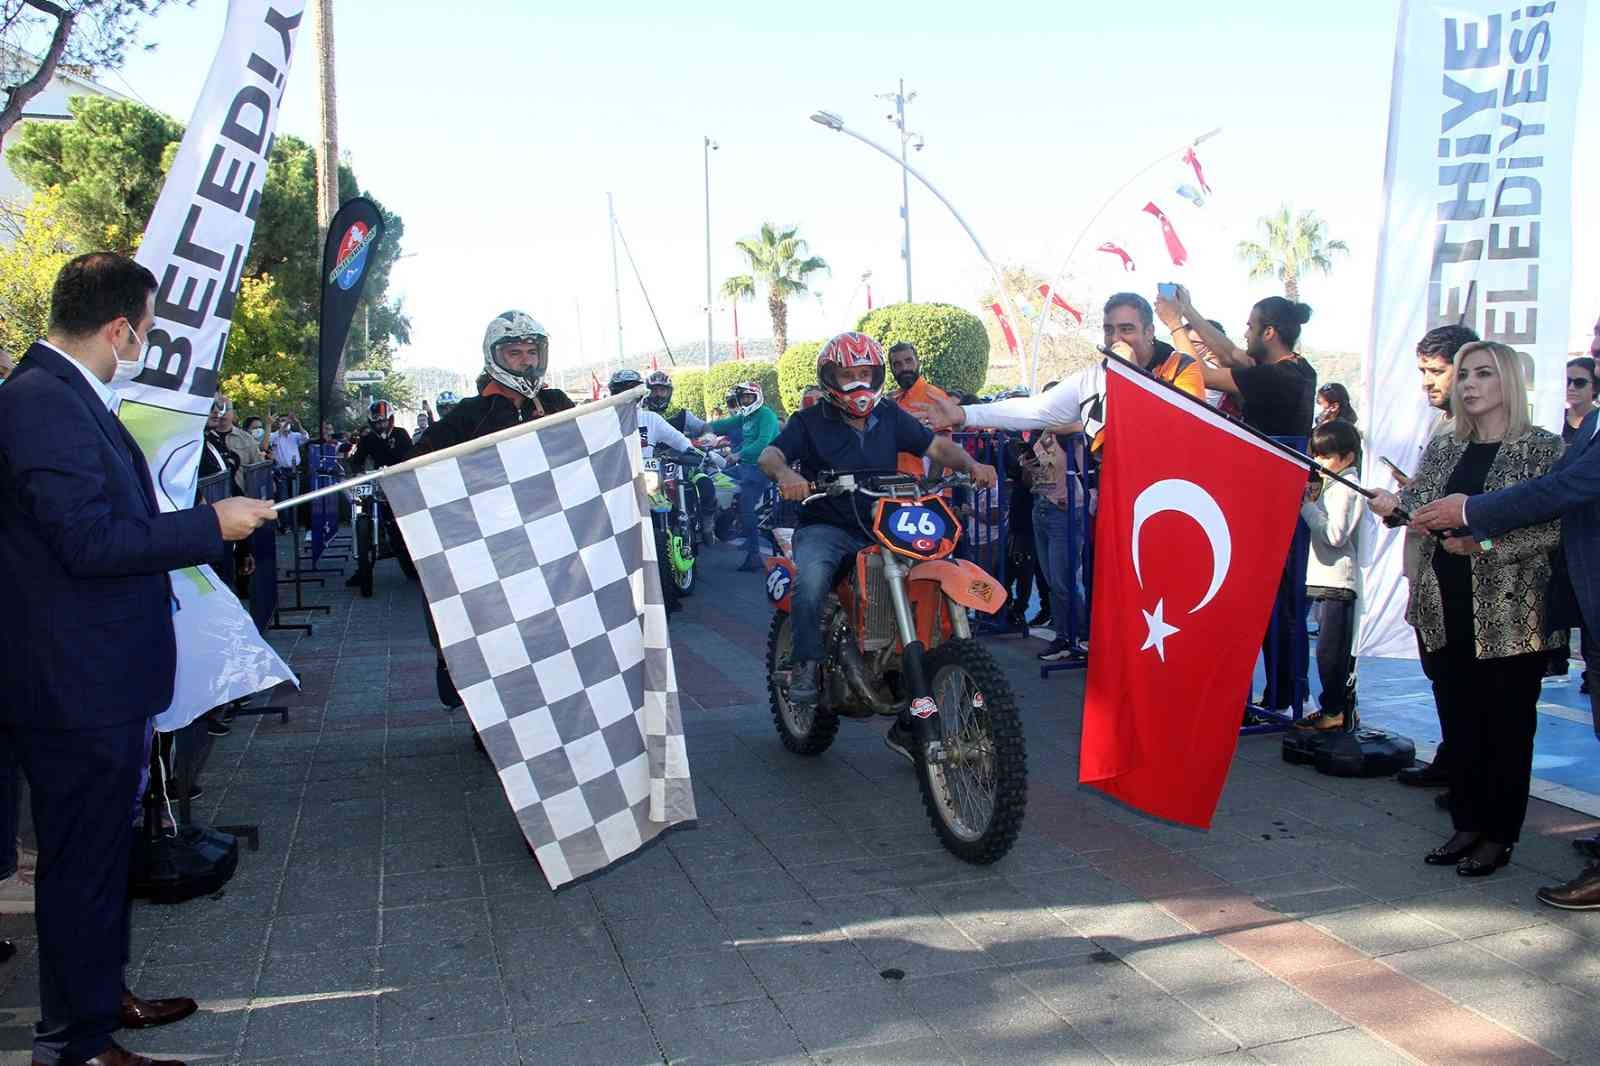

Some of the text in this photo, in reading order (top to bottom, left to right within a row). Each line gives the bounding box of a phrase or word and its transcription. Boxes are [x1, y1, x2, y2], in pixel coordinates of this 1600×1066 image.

[1426, 14, 1502, 333] ETHİYE
[1484, 1, 1556, 391] ELEDİYESİ
[767, 570, 790, 600] 46
[897, 511, 936, 536] 46
